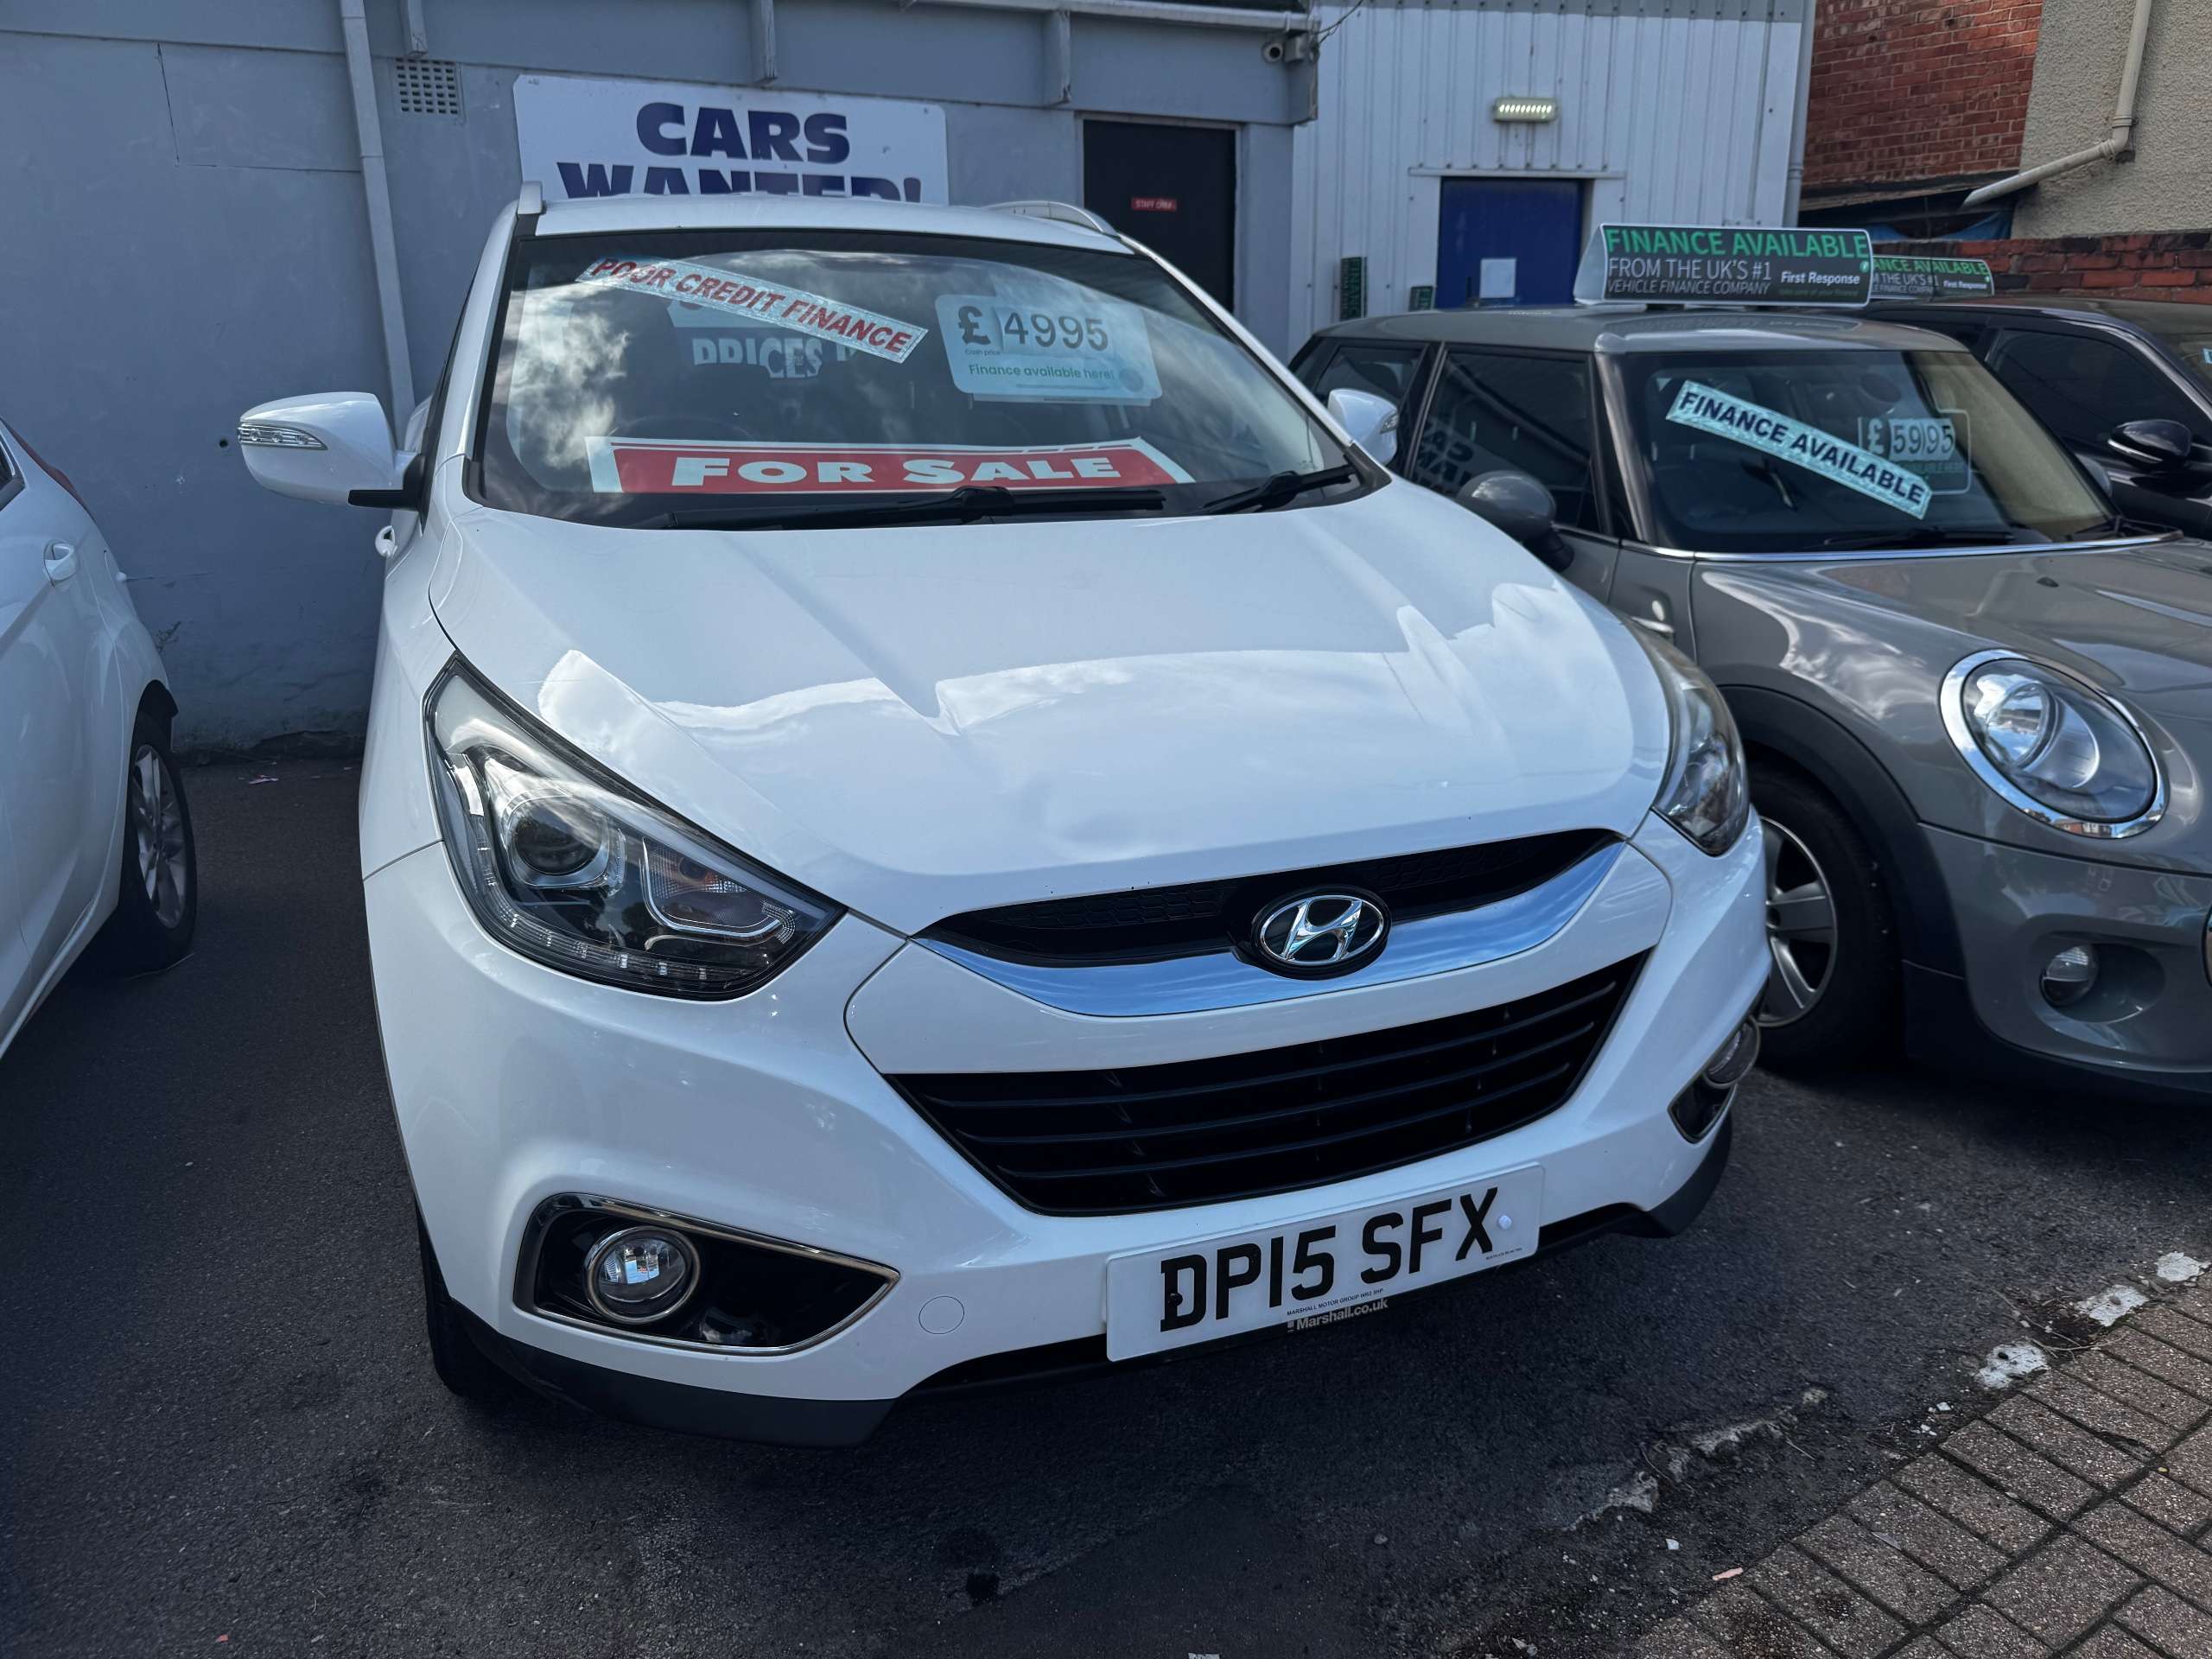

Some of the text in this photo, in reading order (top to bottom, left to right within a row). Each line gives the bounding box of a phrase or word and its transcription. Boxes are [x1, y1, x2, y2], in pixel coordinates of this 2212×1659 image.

[636, 101, 851, 164] CARS
[1605, 228, 1870, 258] FINANCE AVAILABLE
[1608, 257, 1772, 281] FROM THE UK'S #1
[1781, 271, 1807, 283] First
[1808, 272, 1860, 286] Response
[1880, 273, 1902, 285] THE
[1914, 259, 1989, 275] AVAILABLE
[1607, 278, 1656, 294] VEHICLE
[1658, 279, 1716, 295] FINANCE
[1719, 280, 1771, 296] COMPANY
[590, 259, 677, 288] POOR
[676, 273, 786, 313] CREDIT
[781, 299, 914, 354] FINANCE
[969, 364, 1021, 376] Finance
[1023, 365, 1081, 378] available
[1678, 391, 1925, 505] FINANCE AVAILABLE
[671, 455, 1122, 486] FOR SALE
[1160, 1186, 1498, 1332] DP15 SFX
[1287, 1305, 1318, 1316] MARSHALL
[1318, 1299, 1339, 1308] MOTOR
[1339, 1294, 1359, 1303] GROUP
[1296, 1298, 1389, 1330] Marshall.co.uk
